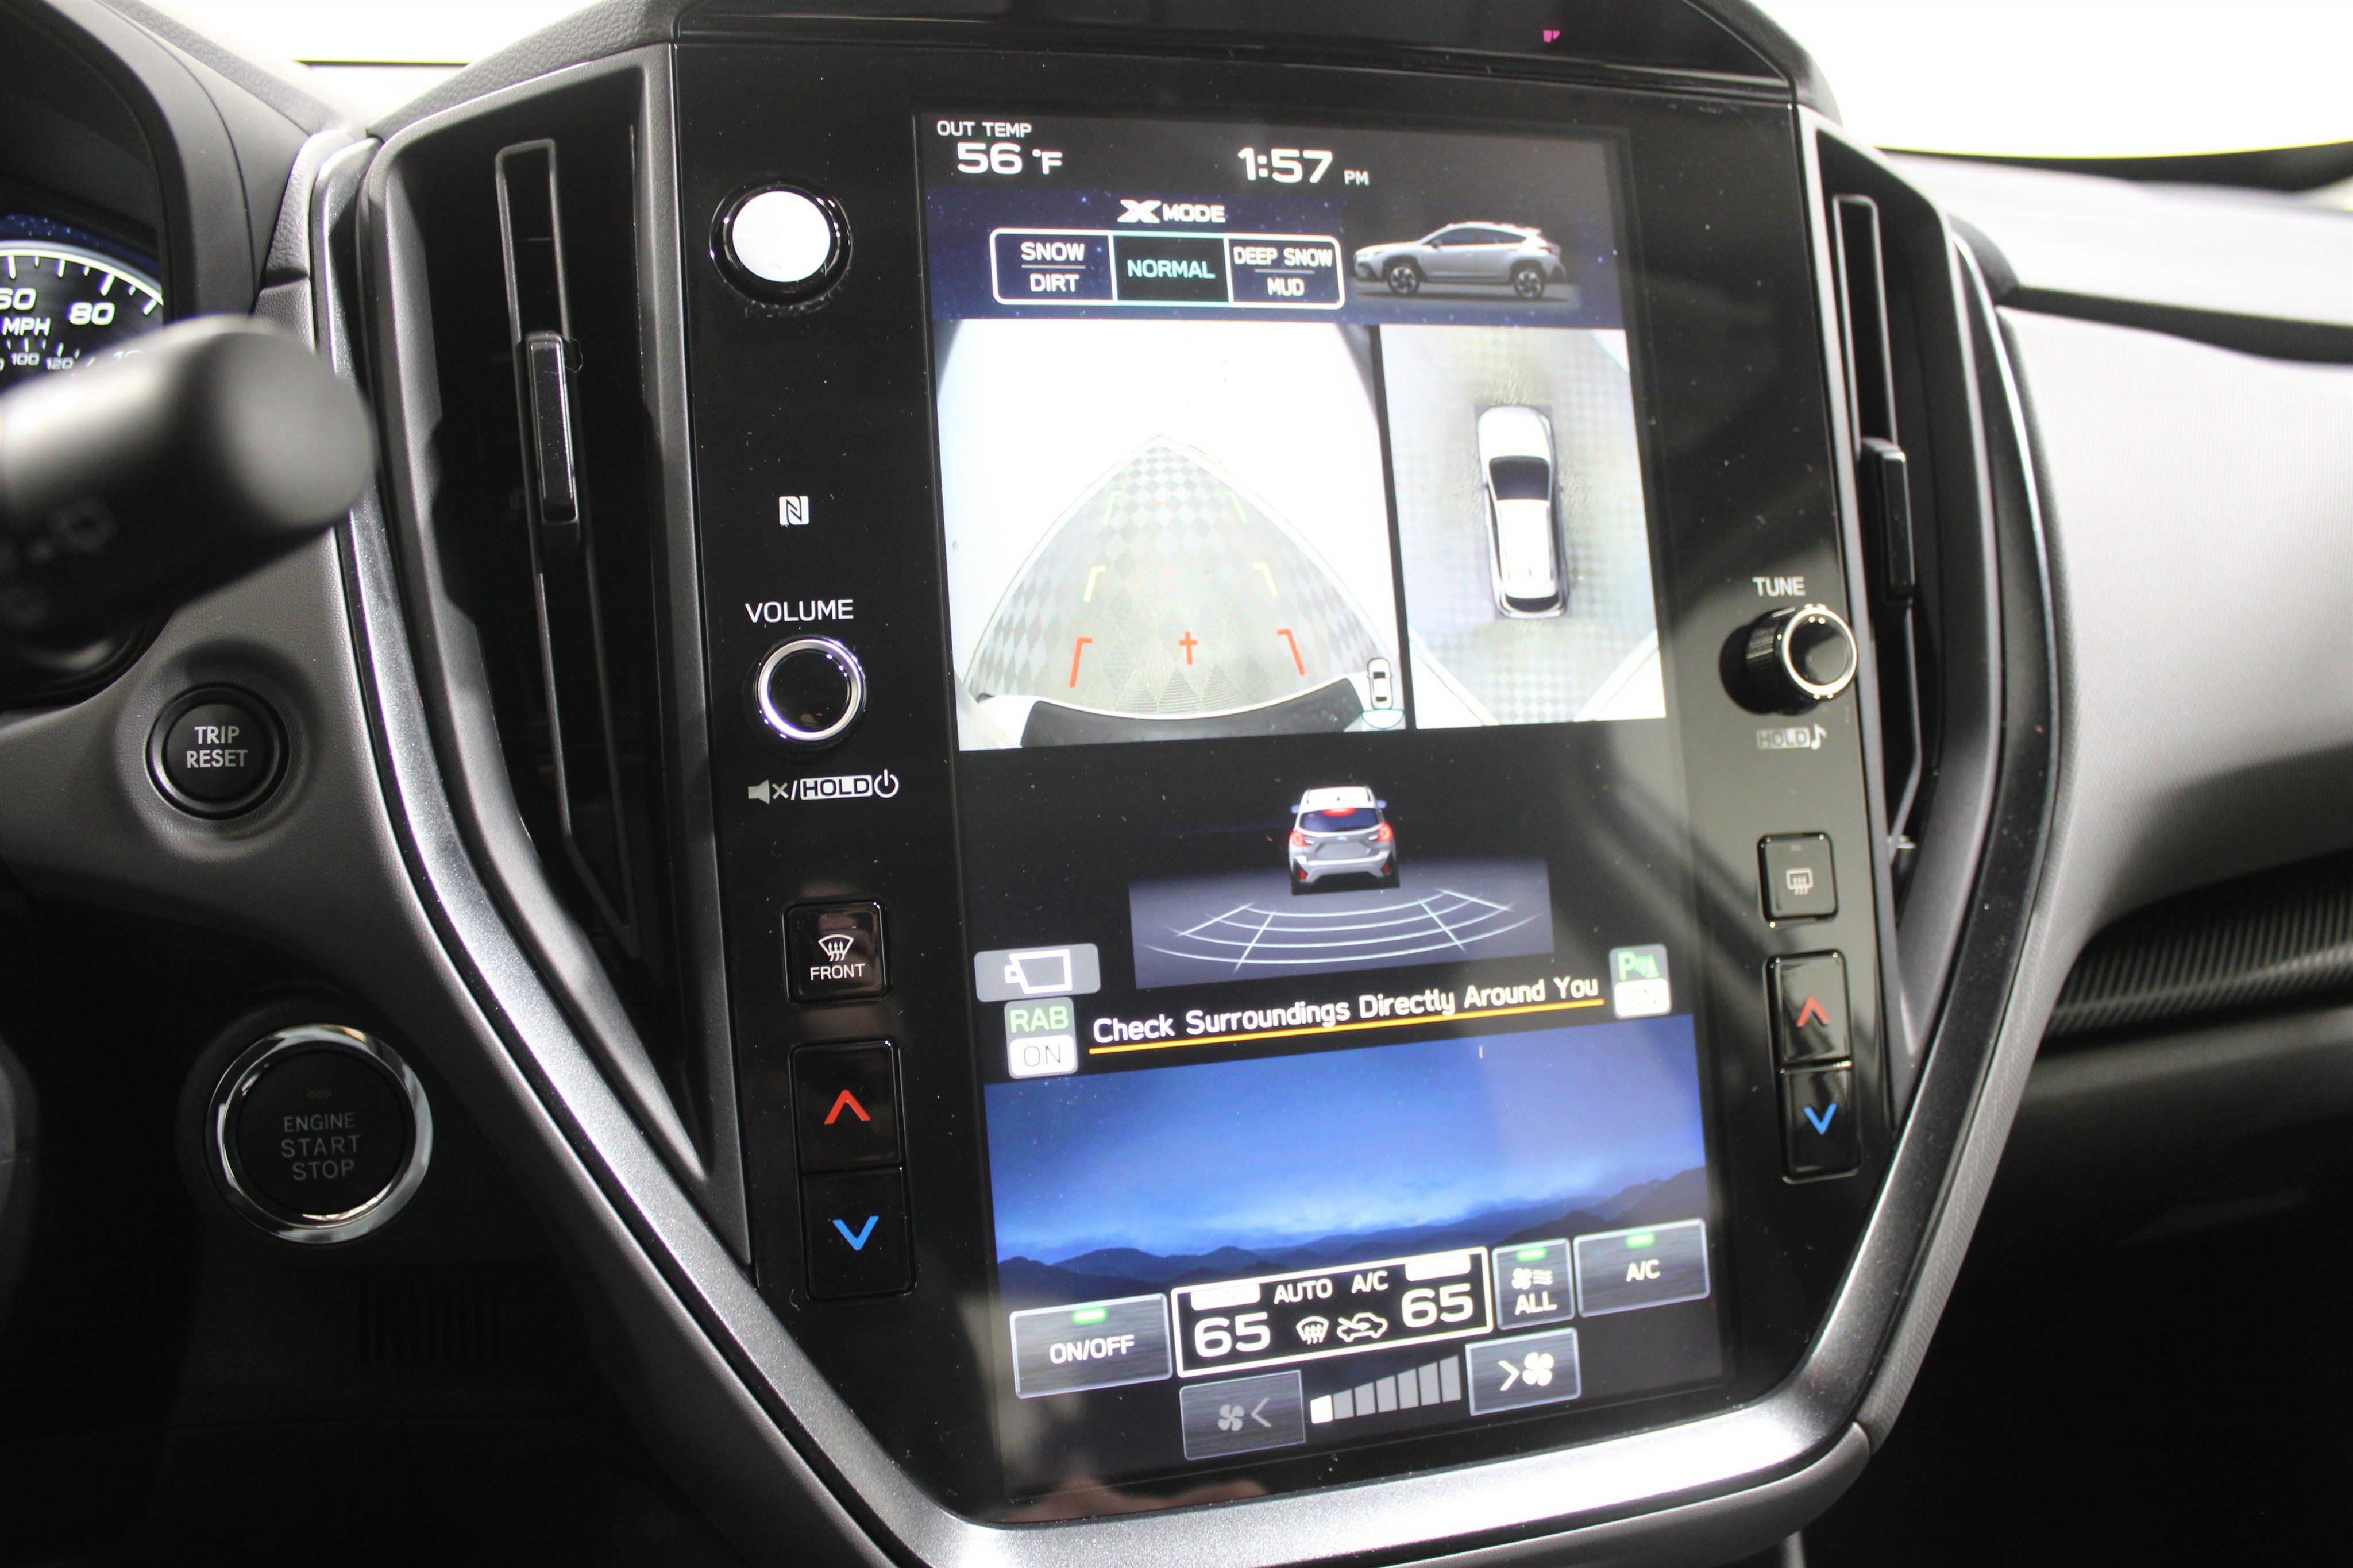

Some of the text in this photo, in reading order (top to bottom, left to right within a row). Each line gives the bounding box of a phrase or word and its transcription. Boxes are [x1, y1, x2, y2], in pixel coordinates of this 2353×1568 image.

[936, 119, 1032, 138] OUT TEMP
[956, 142, 1023, 175] 56
[1237, 146, 1370, 186] 1:57 PM
[1162, 204, 1226, 223] MODE
[1020, 241, 1085, 262] SNOW
[1233, 245, 1333, 268] DEEP SNOW
[1126, 258, 1216, 280] NORMAL
[1029, 273, 1080, 293] DIRT
[1267, 277, 1305, 297] MUD
[68, 302, 115, 325] 80
[1, 316, 51, 337] MPH
[11, 352, 40, 366] 100
[45, 356, 75, 370] 120
[1752, 576, 1806, 597] TUNE
[745, 598, 854, 623] VOLUME
[194, 725, 240, 744] TRIP
[1757, 728, 1810, 749] HOLD
[186, 749, 248, 768] RESET
[810, 963, 866, 981] FRONT
[1009, 1005, 1069, 1033] RAB
[1093, 975, 1599, 1044] Check Surroundings Directly Around You
[1023, 1044, 1062, 1067] ON
[284, 1112, 355, 1133] ENGINE
[281, 1134, 361, 1158] START
[292, 1159, 354, 1181] STOP
[1625, 1258, 1660, 1283] A/C
[1273, 1277, 1333, 1304] AUTO
[1351, 1270, 1389, 1294] A/C
[1401, 1283, 1474, 1328] 65
[1514, 1292, 1557, 1316] ALL
[1194, 1311, 1271, 1358] 65
[1050, 1334, 1135, 1364] ON/OFF
